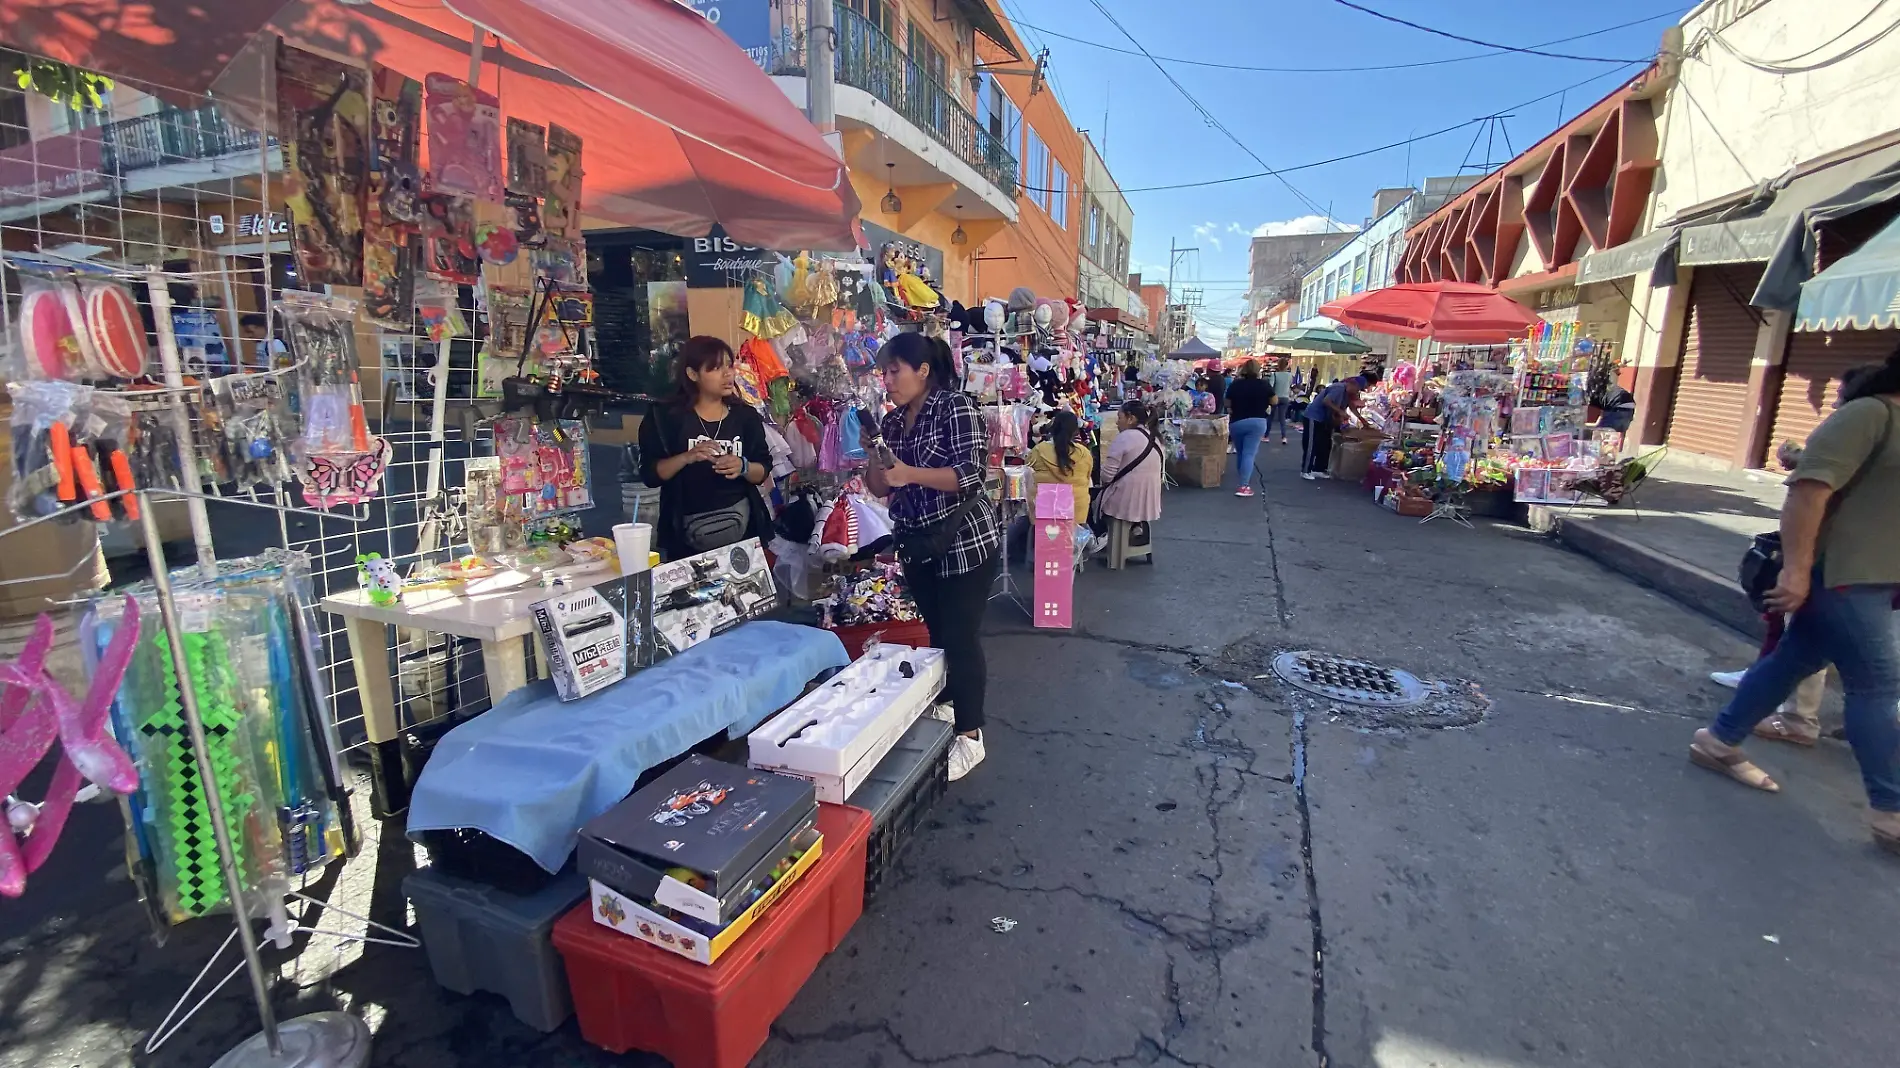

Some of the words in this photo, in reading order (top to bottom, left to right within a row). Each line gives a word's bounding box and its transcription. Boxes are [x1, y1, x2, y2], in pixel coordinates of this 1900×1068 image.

[694, 236, 768, 253] BIS
[713, 255, 764, 276] Boutique
[574, 645, 599, 665] M762
